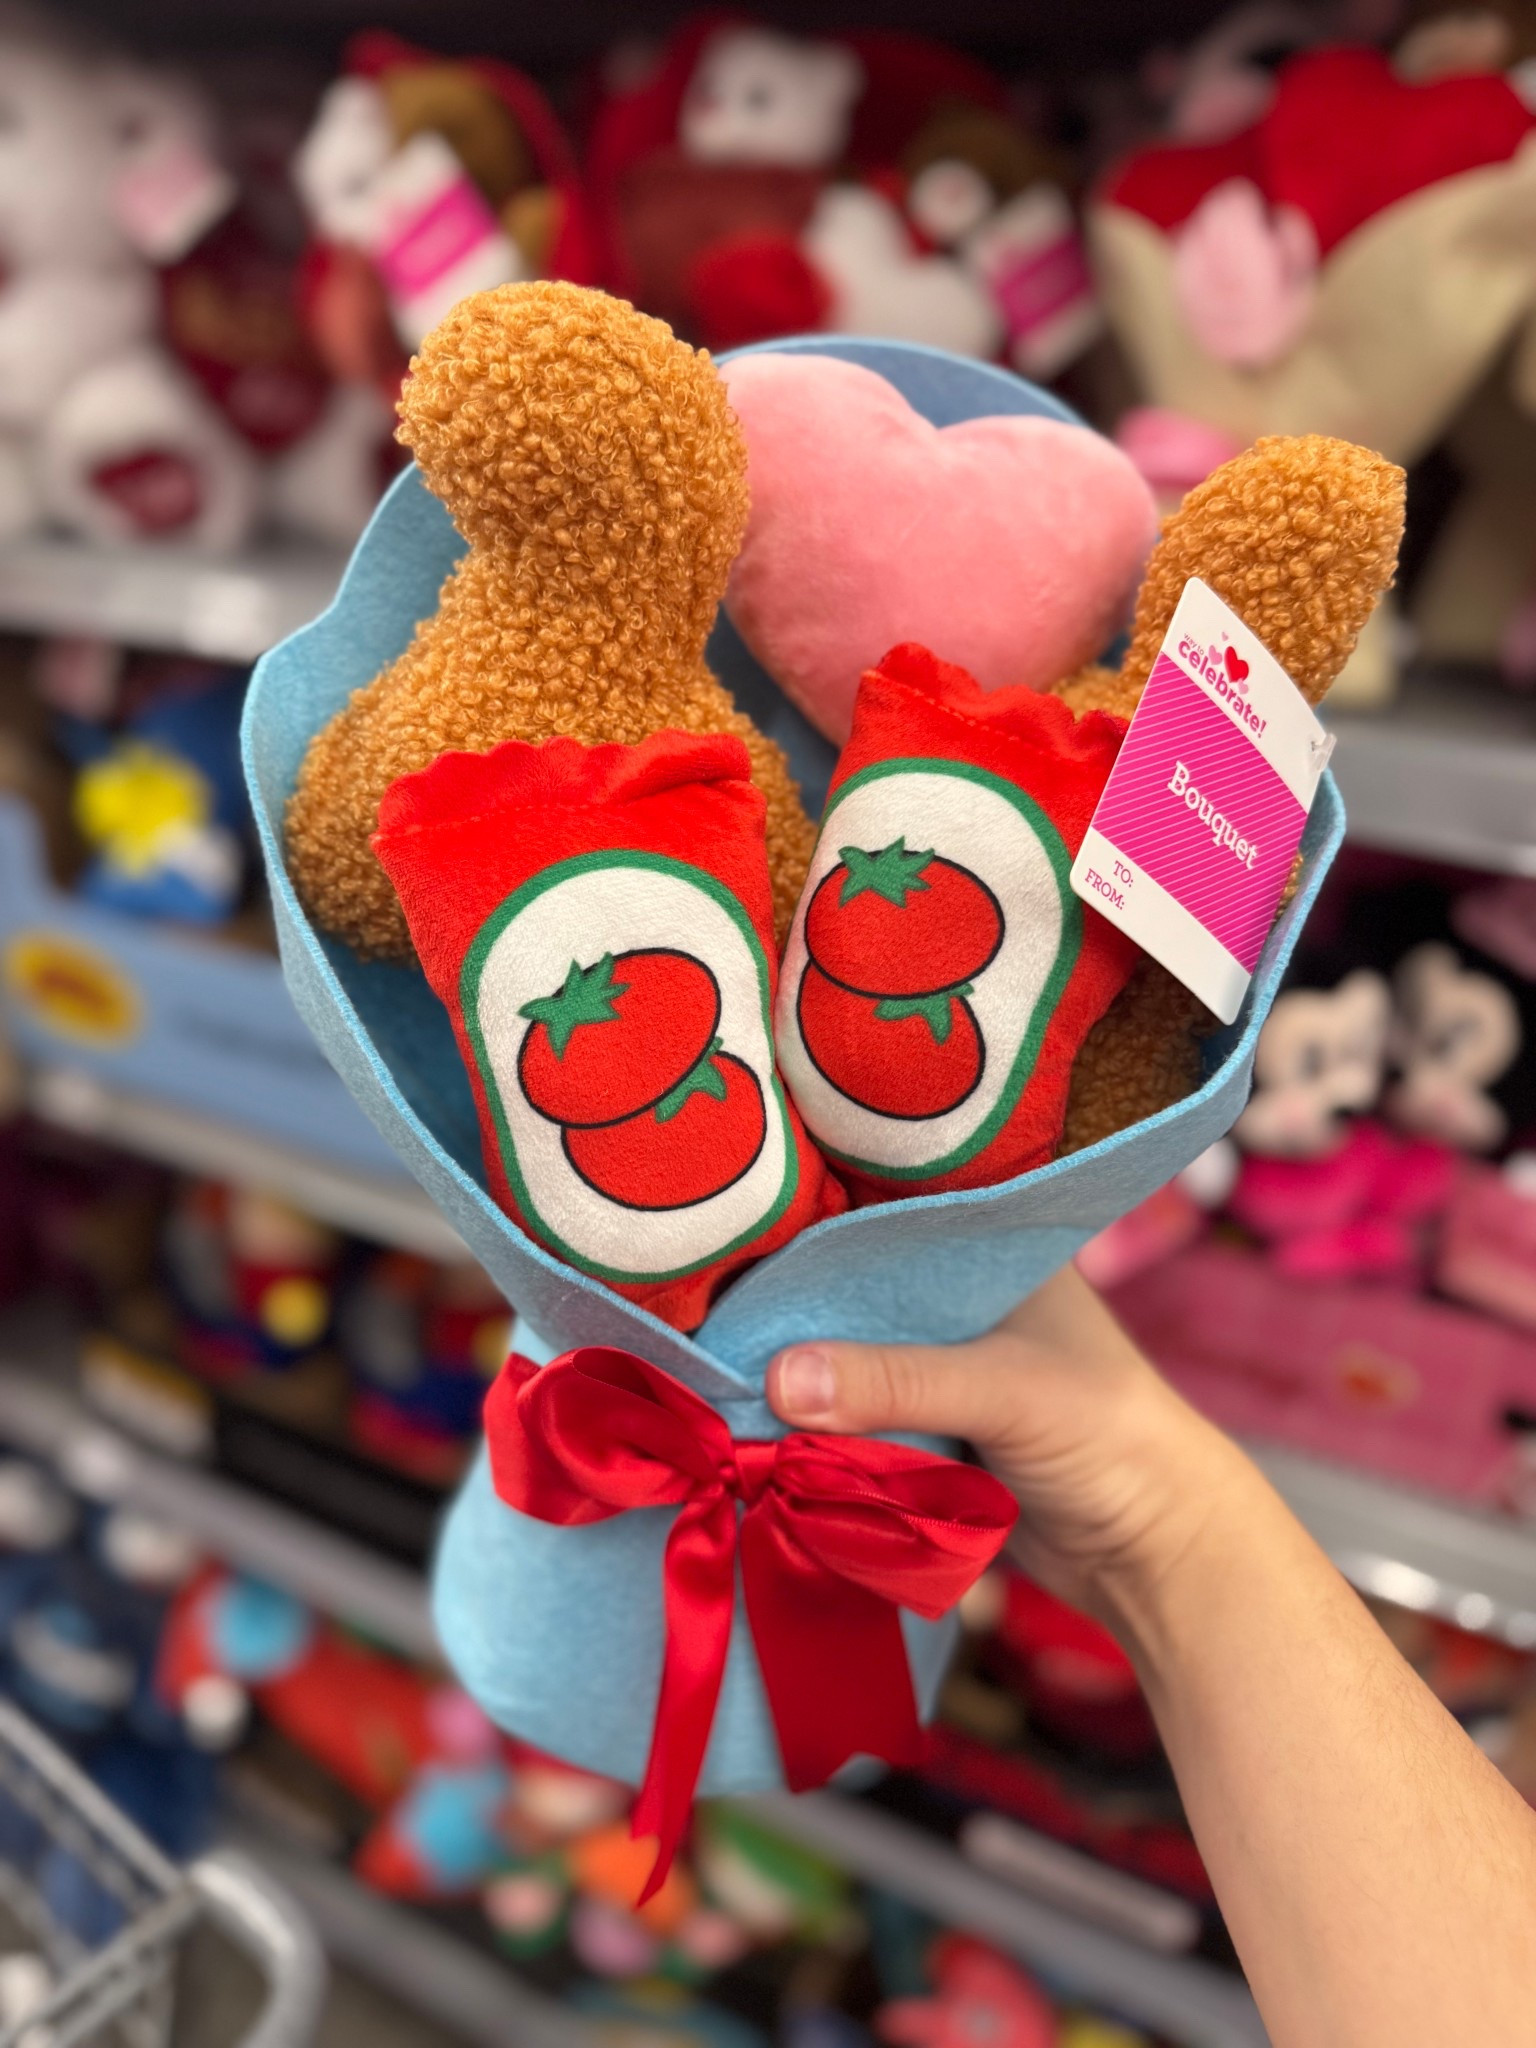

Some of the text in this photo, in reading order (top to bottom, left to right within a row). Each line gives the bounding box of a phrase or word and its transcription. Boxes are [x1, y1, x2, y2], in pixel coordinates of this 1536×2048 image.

[1183, 632, 1198, 649] way
[1178, 640, 1267, 739] celebrate!
[1167, 760, 1259, 870] Bouquet
[1084, 868, 1125, 910] FROM:
[1112, 860, 1134, 888] TO:
